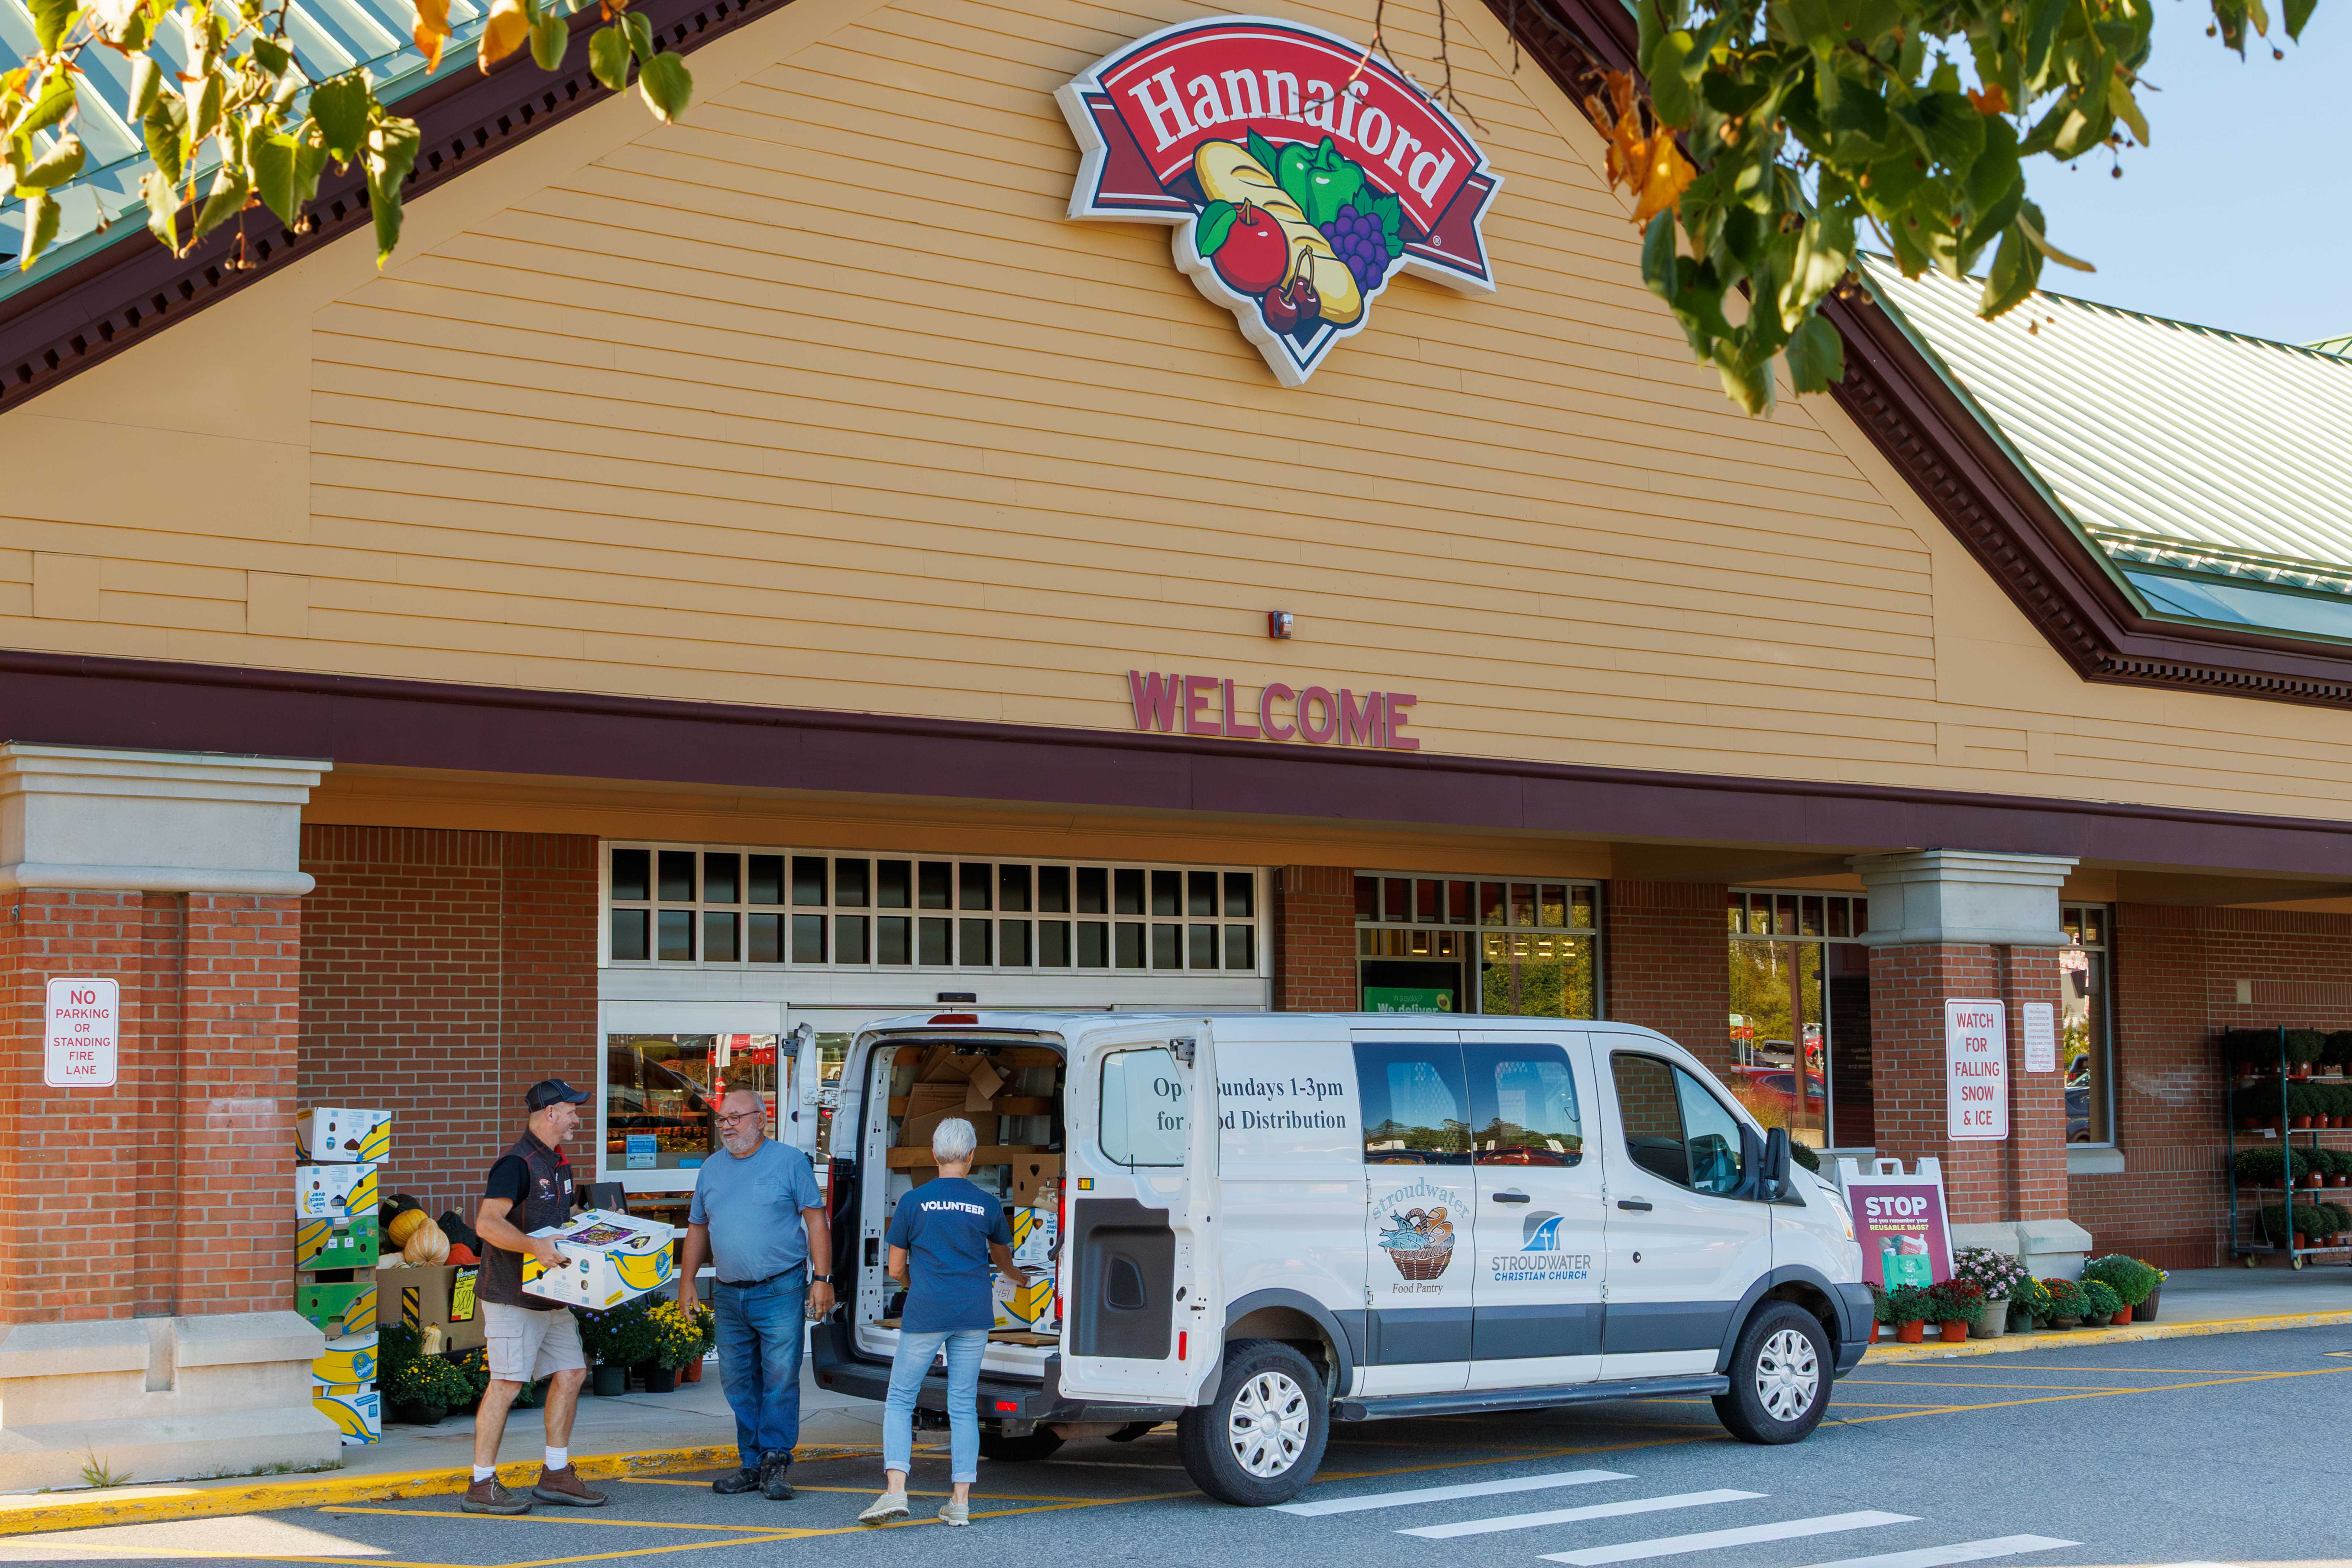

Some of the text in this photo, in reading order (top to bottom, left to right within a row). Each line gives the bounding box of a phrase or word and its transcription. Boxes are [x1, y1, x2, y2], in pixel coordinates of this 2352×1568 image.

[1129, 66, 1456, 208] Hannaford
[1127, 669, 1420, 750] WELCOME
[70, 990, 96, 1005] NO
[56, 1009, 109, 1019] PARKING
[1377, 1003, 1438, 1013] We deliver
[74, 1023, 90, 1032] OR
[1956, 1013, 1994, 1028] WATCH
[53, 1037, 110, 1047] STANDING
[1966, 1037, 1987, 1052] FOR
[69, 1051, 94, 1060] FIRE
[66, 1065, 97, 1075] LANE
[1955, 1061, 2000, 1077] FALLING
[1154, 1077, 1184, 1102] Op
[1289, 1077, 1344, 1101] 1-3pm
[1961, 1086, 1994, 1101] SNOW
[1157, 1111, 1184, 1130] for
[1240, 1110, 1346, 1129] Distribution
[1963, 1110, 1992, 1125] & ICE
[1372, 1177, 1470, 1220] stroudwater
[1865, 1196, 1927, 1216] STOP
[921, 1201, 985, 1216] VOLUNTEER
[1491, 1255, 1591, 1272] STROUDWATER
[1494, 1270, 1587, 1281] CHRISTIAN CHURCH
[1392, 1282, 1443, 1296] Food Pantry
[356, 1362, 374, 1377] Chiquita
